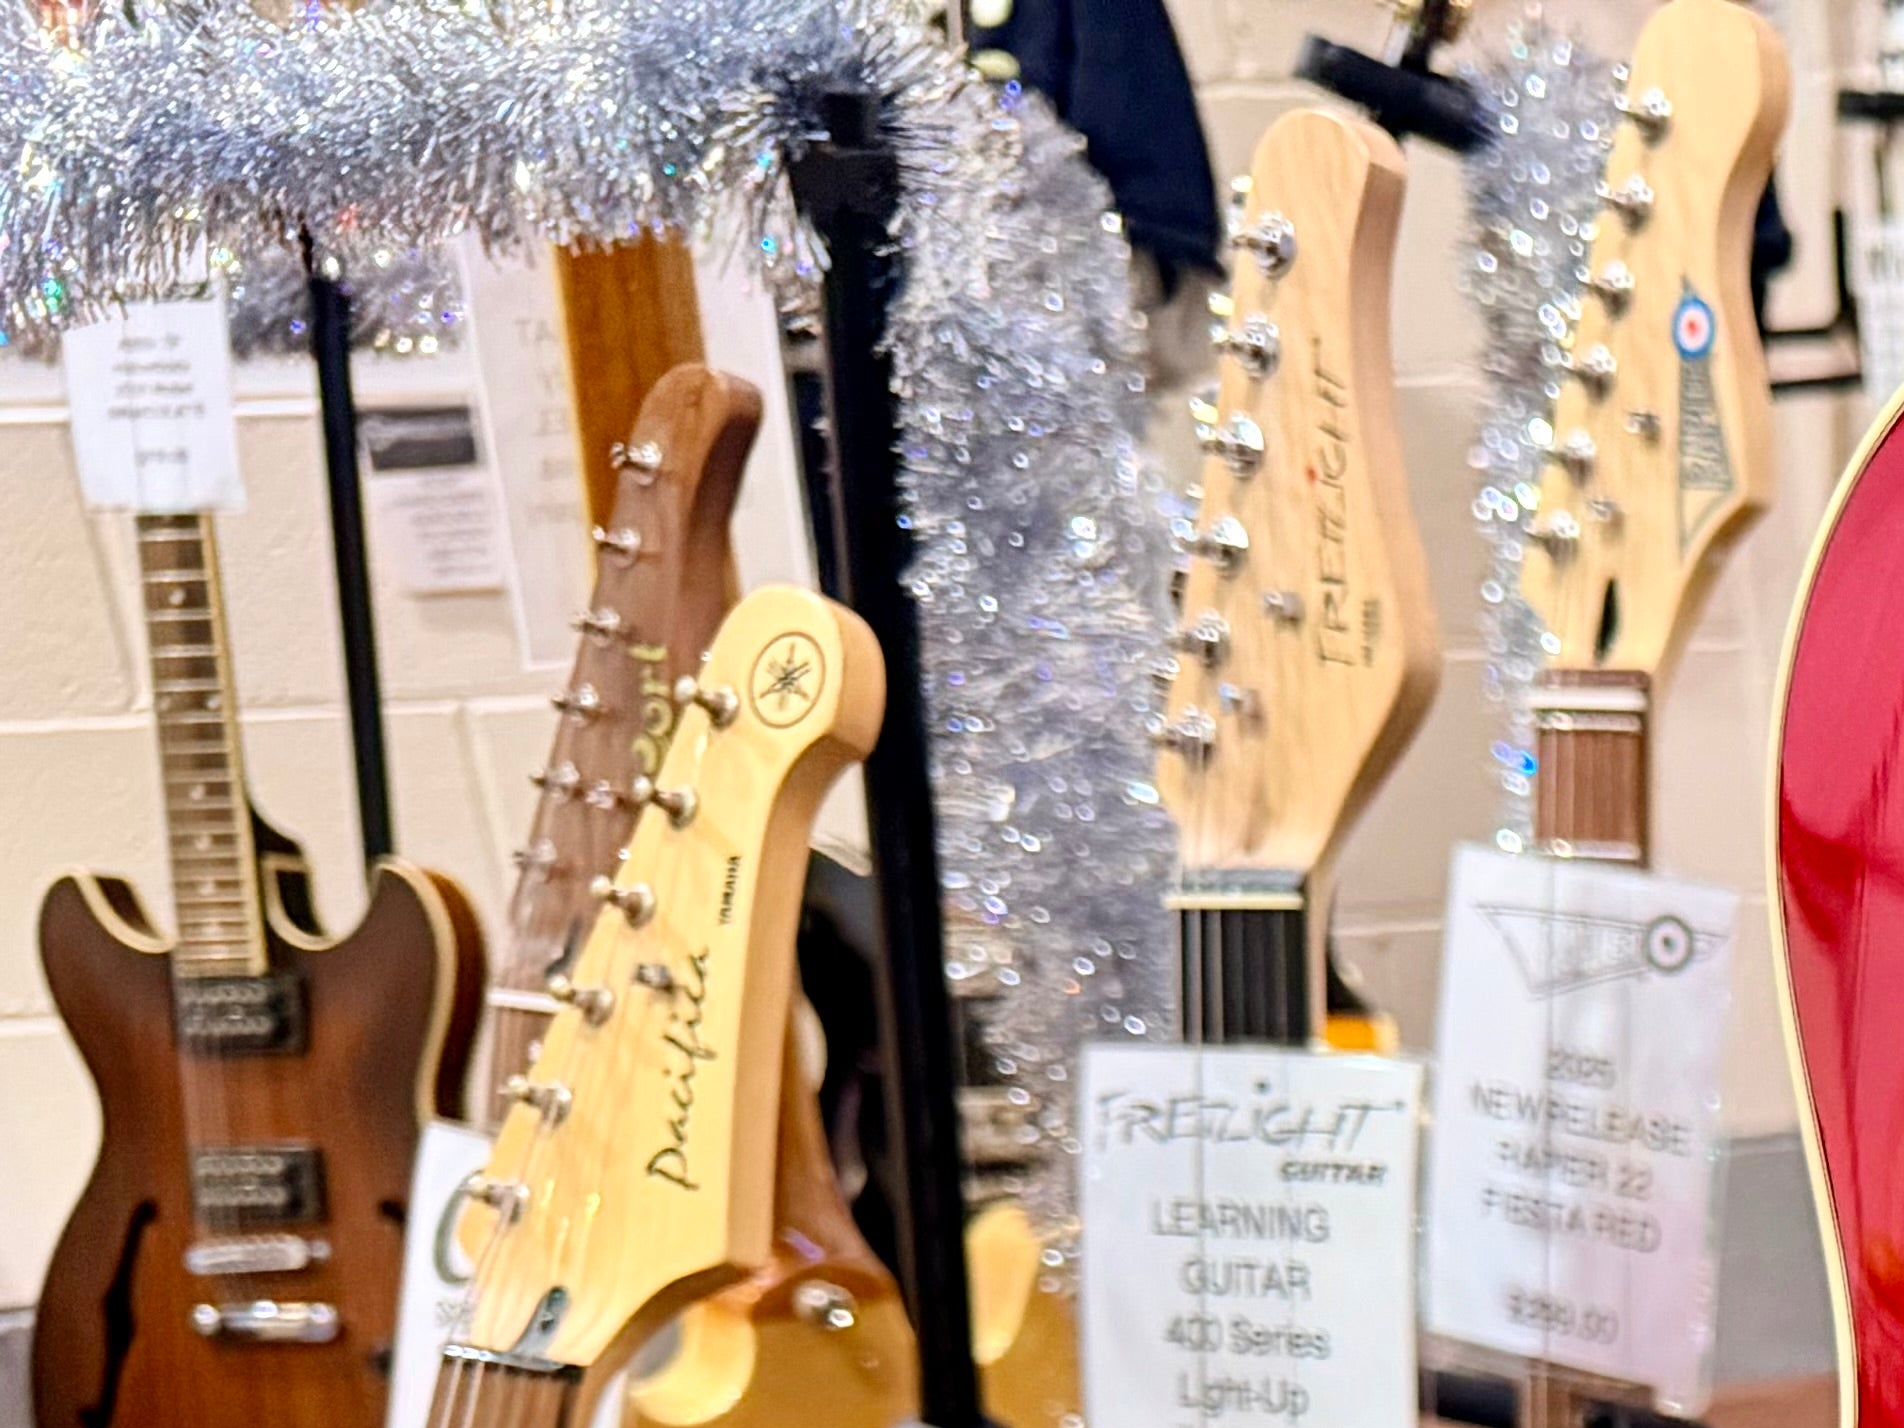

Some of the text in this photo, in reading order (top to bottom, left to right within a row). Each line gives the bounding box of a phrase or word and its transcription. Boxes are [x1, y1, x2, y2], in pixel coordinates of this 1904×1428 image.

[718, 855, 743, 926] YAMAHA
[645, 944, 719, 1192] Pacifica
[1470, 1079, 1694, 1159] NEW RELEASE
[1280, 1159, 1388, 1186] GUITAR
[1150, 1198, 1331, 1244] LEARNING
[1591, 1203, 1663, 1254] RED
[1180, 1253, 1312, 1301] GUITAR
[1164, 1313, 1331, 1361] 400 Series
[1176, 1371, 1311, 1424] Light-Up
